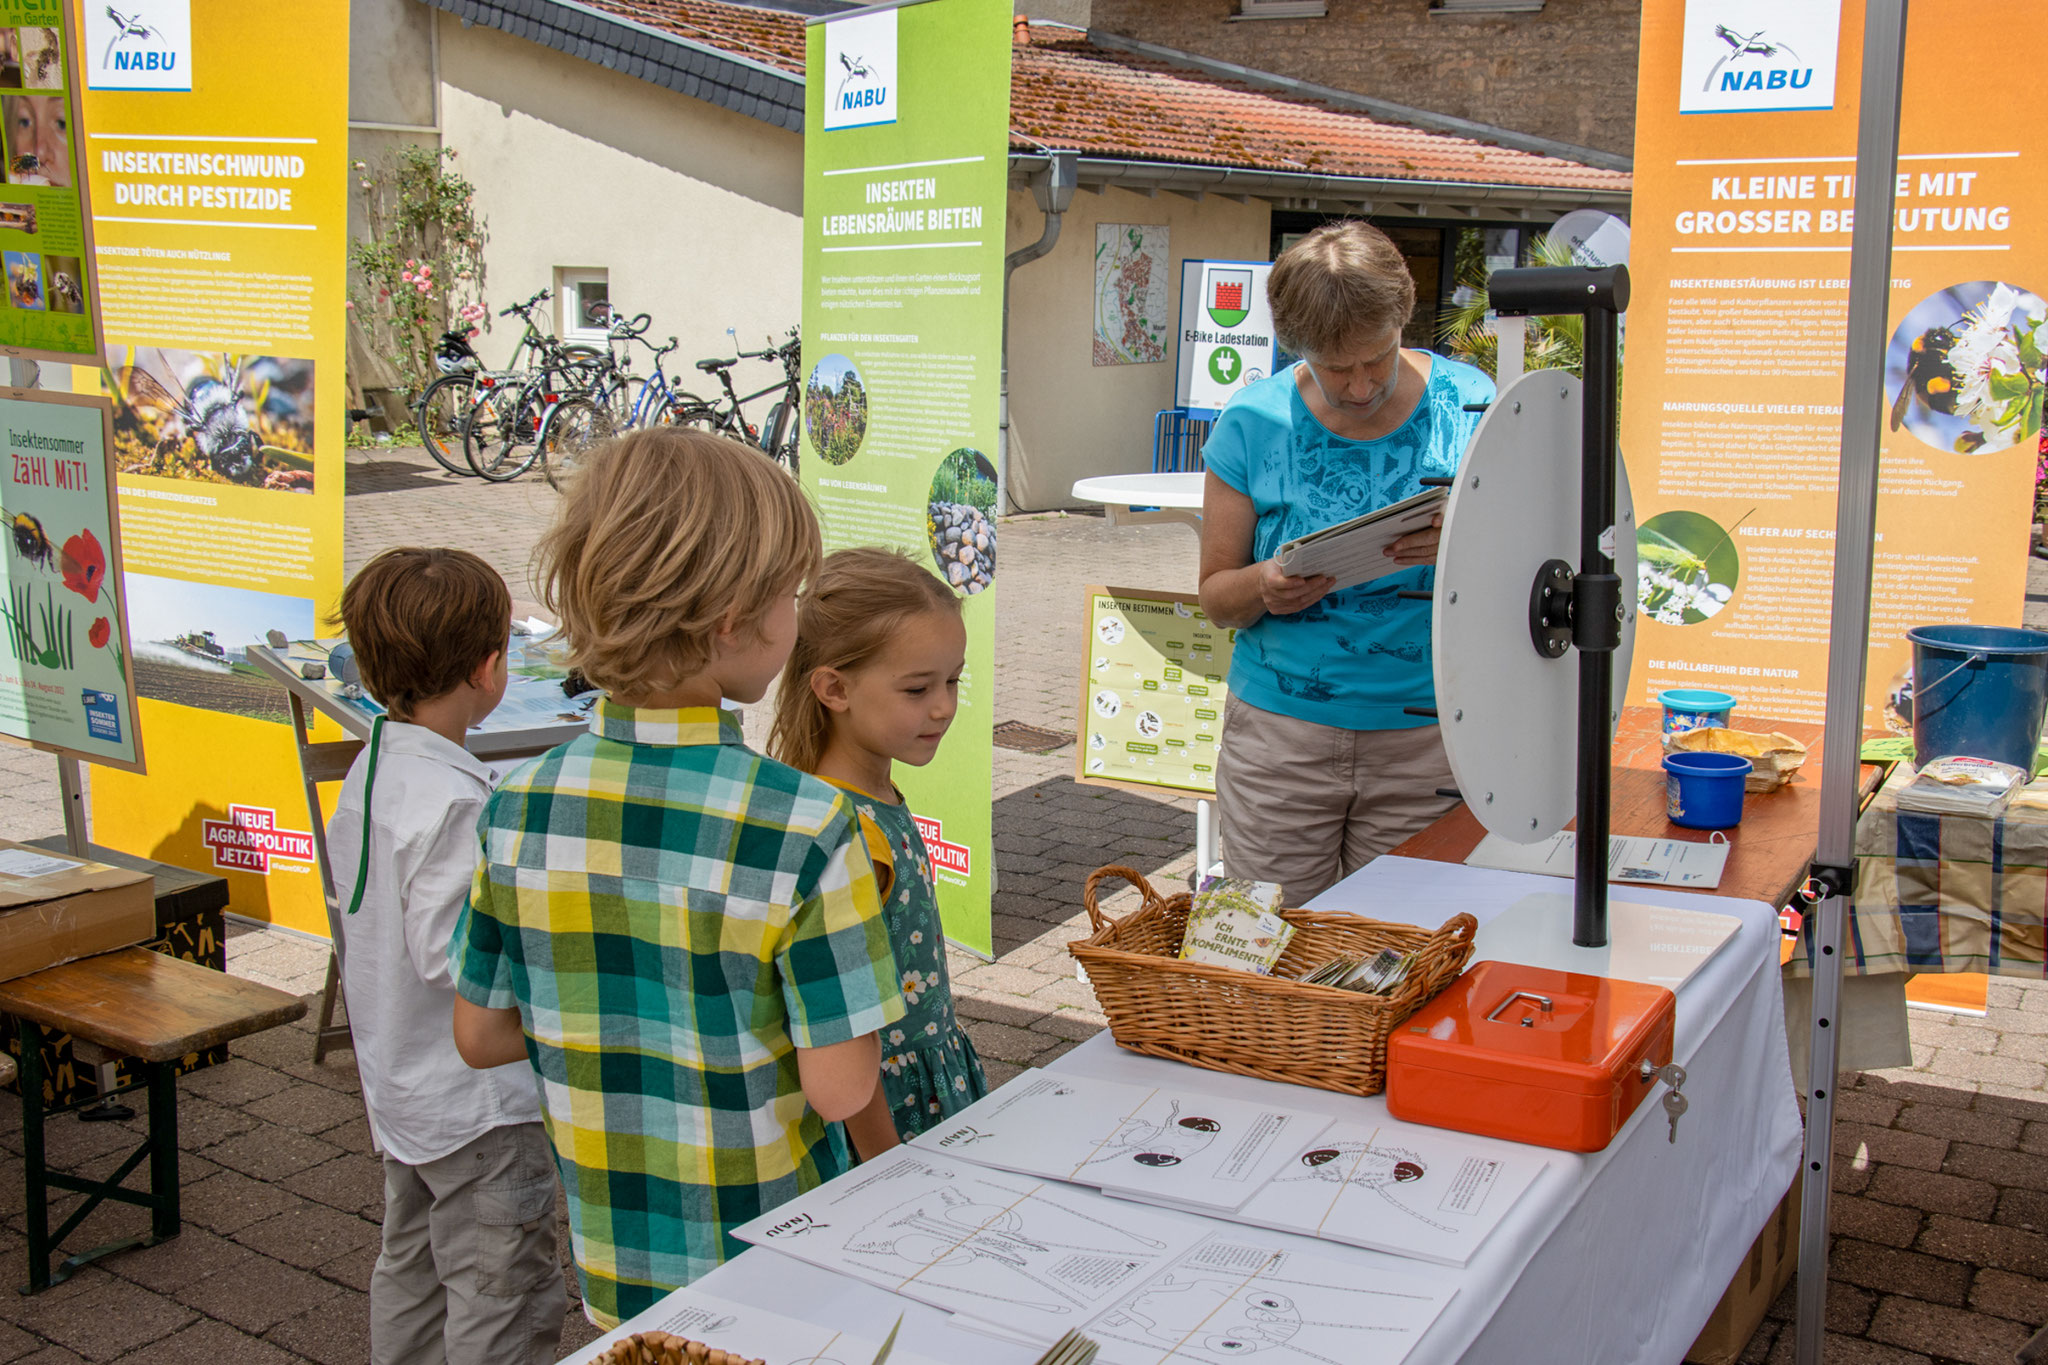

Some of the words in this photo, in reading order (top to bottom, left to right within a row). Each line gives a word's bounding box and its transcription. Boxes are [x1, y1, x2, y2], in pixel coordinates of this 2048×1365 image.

[9, 11, 22, 25] im
[24, 11, 59, 25] Garten
[114, 51, 176, 71] NABU
[1720, 68, 1813, 92] NABU
[842, 86, 886, 110] NABU
[102, 150, 305, 179] INSEKTENSCHWUND
[866, 177, 936, 203] INSEKTEN
[1711, 175, 1816, 200] KLEINE
[1823, 174, 1910, 198] TIE
[1918, 172, 1977, 196] MIT
[115, 183, 183, 207] DURCH
[188, 185, 292, 211] PESTIZIDE
[822, 207, 924, 236] LEBENSRÄUME
[927, 206, 982, 230] BIETEN
[1675, 210, 1812, 234] GROSSER
[1819, 206, 2010, 233] BEUTUNG
[141, 247, 166, 258] TÖTEN
[166, 249, 187, 259] AUCH
[188, 248, 231, 262] NÜTZLINGE
[1670, 277, 1796, 289] INSEKTENBESTÄUBUNG
[1798, 279, 1816, 289] IST
[1736, 298, 1792, 307] Kulturpflanzen
[1793, 298, 1822, 306] werden
[1744, 308, 1784, 318] Bedeutung
[1802, 308, 1822, 316] dabei
[820, 333, 848, 342] PFLANZEN
[849, 332, 858, 342] FÜR
[860, 334, 872, 343] DEN
[1185, 330, 1213, 344] E-Bike
[1215, 331, 1269, 347] Ladestation
[1735, 328, 1771, 338] wichtigen
[1735, 338, 1778, 348] angebauten
[1780, 339, 1833, 348] Kulturpflanzen
[1777, 358, 1819, 367] Totalverlust
[1782, 369, 1810, 377] Prozent
[1664, 402, 1764, 414] NAHRUNGSQUELLE
[1766, 404, 1805, 414] VIELER
[8, 428, 84, 455] Insektensommer
[818, 478, 830, 486] BAU
[830, 478, 842, 488] VON
[842, 479, 888, 494] LEBENSRÄUMEN
[132, 488, 146, 498] DES
[1738, 526, 1780, 537] HELFER
[1782, 528, 1804, 538] AUF
[1746, 546, 1776, 554] Insekten
[1794, 548, 1824, 556] wichtige
[1792, 567, 1830, 576] Förderung
[1748, 575, 1790, 584] Bestandteil
[1790, 576, 1802, 584] der
[1789, 586, 1820, 594] Insekten
[1910, 584, 1958, 594] Ausbreitung
[1889, 592, 1899, 600] So
[1918, 594, 1974, 604] beispielsweise
[1098, 600, 1132, 613] INSEKTEN
[1133, 603, 1174, 616] BESTIMMEN
[1875, 602, 1912, 610] besonders
[1954, 606, 1967, 614] der
[1782, 616, 1802, 624] gerne
[1916, 614, 1944, 622] kleinen
[1725, 622, 1760, 630] aufhalten.
[1762, 624, 1794, 632] Laufkäfer
[1648, 659, 1666, 670] DIE
[1668, 660, 1737, 675] MÜLLABFUHR
[1740, 666, 1761, 676] DER
[1763, 669, 1799, 679] NATUR
[1648, 678, 1676, 686] Insekten
[1678, 680, 1702, 688] spielen
[1704, 682, 1718, 690] eine
[1720, 684, 1748, 694] wichtige
[1750, 686, 1768, 694] Rolle
[1762, 696, 1800, 706] zerkleinern
[89, 710, 116, 721] INSEKTEN
[1772, 706, 1790, 714] wird
[90, 716, 116, 728] SOMMER
[234, 811, 270, 830] NEUE
[208, 827, 311, 855] AGRARPOLITIK
[220, 847, 264, 867] JETZT!
[927, 842, 967, 869] POLITIK
[1214, 921, 1234, 934] ICH
[1214, 932, 1249, 948] ERNTE
[1190, 937, 1266, 966] KOMPLIMENTE.
[939, 1126, 970, 1148] NAJU
[766, 1215, 804, 1238] NAJU
